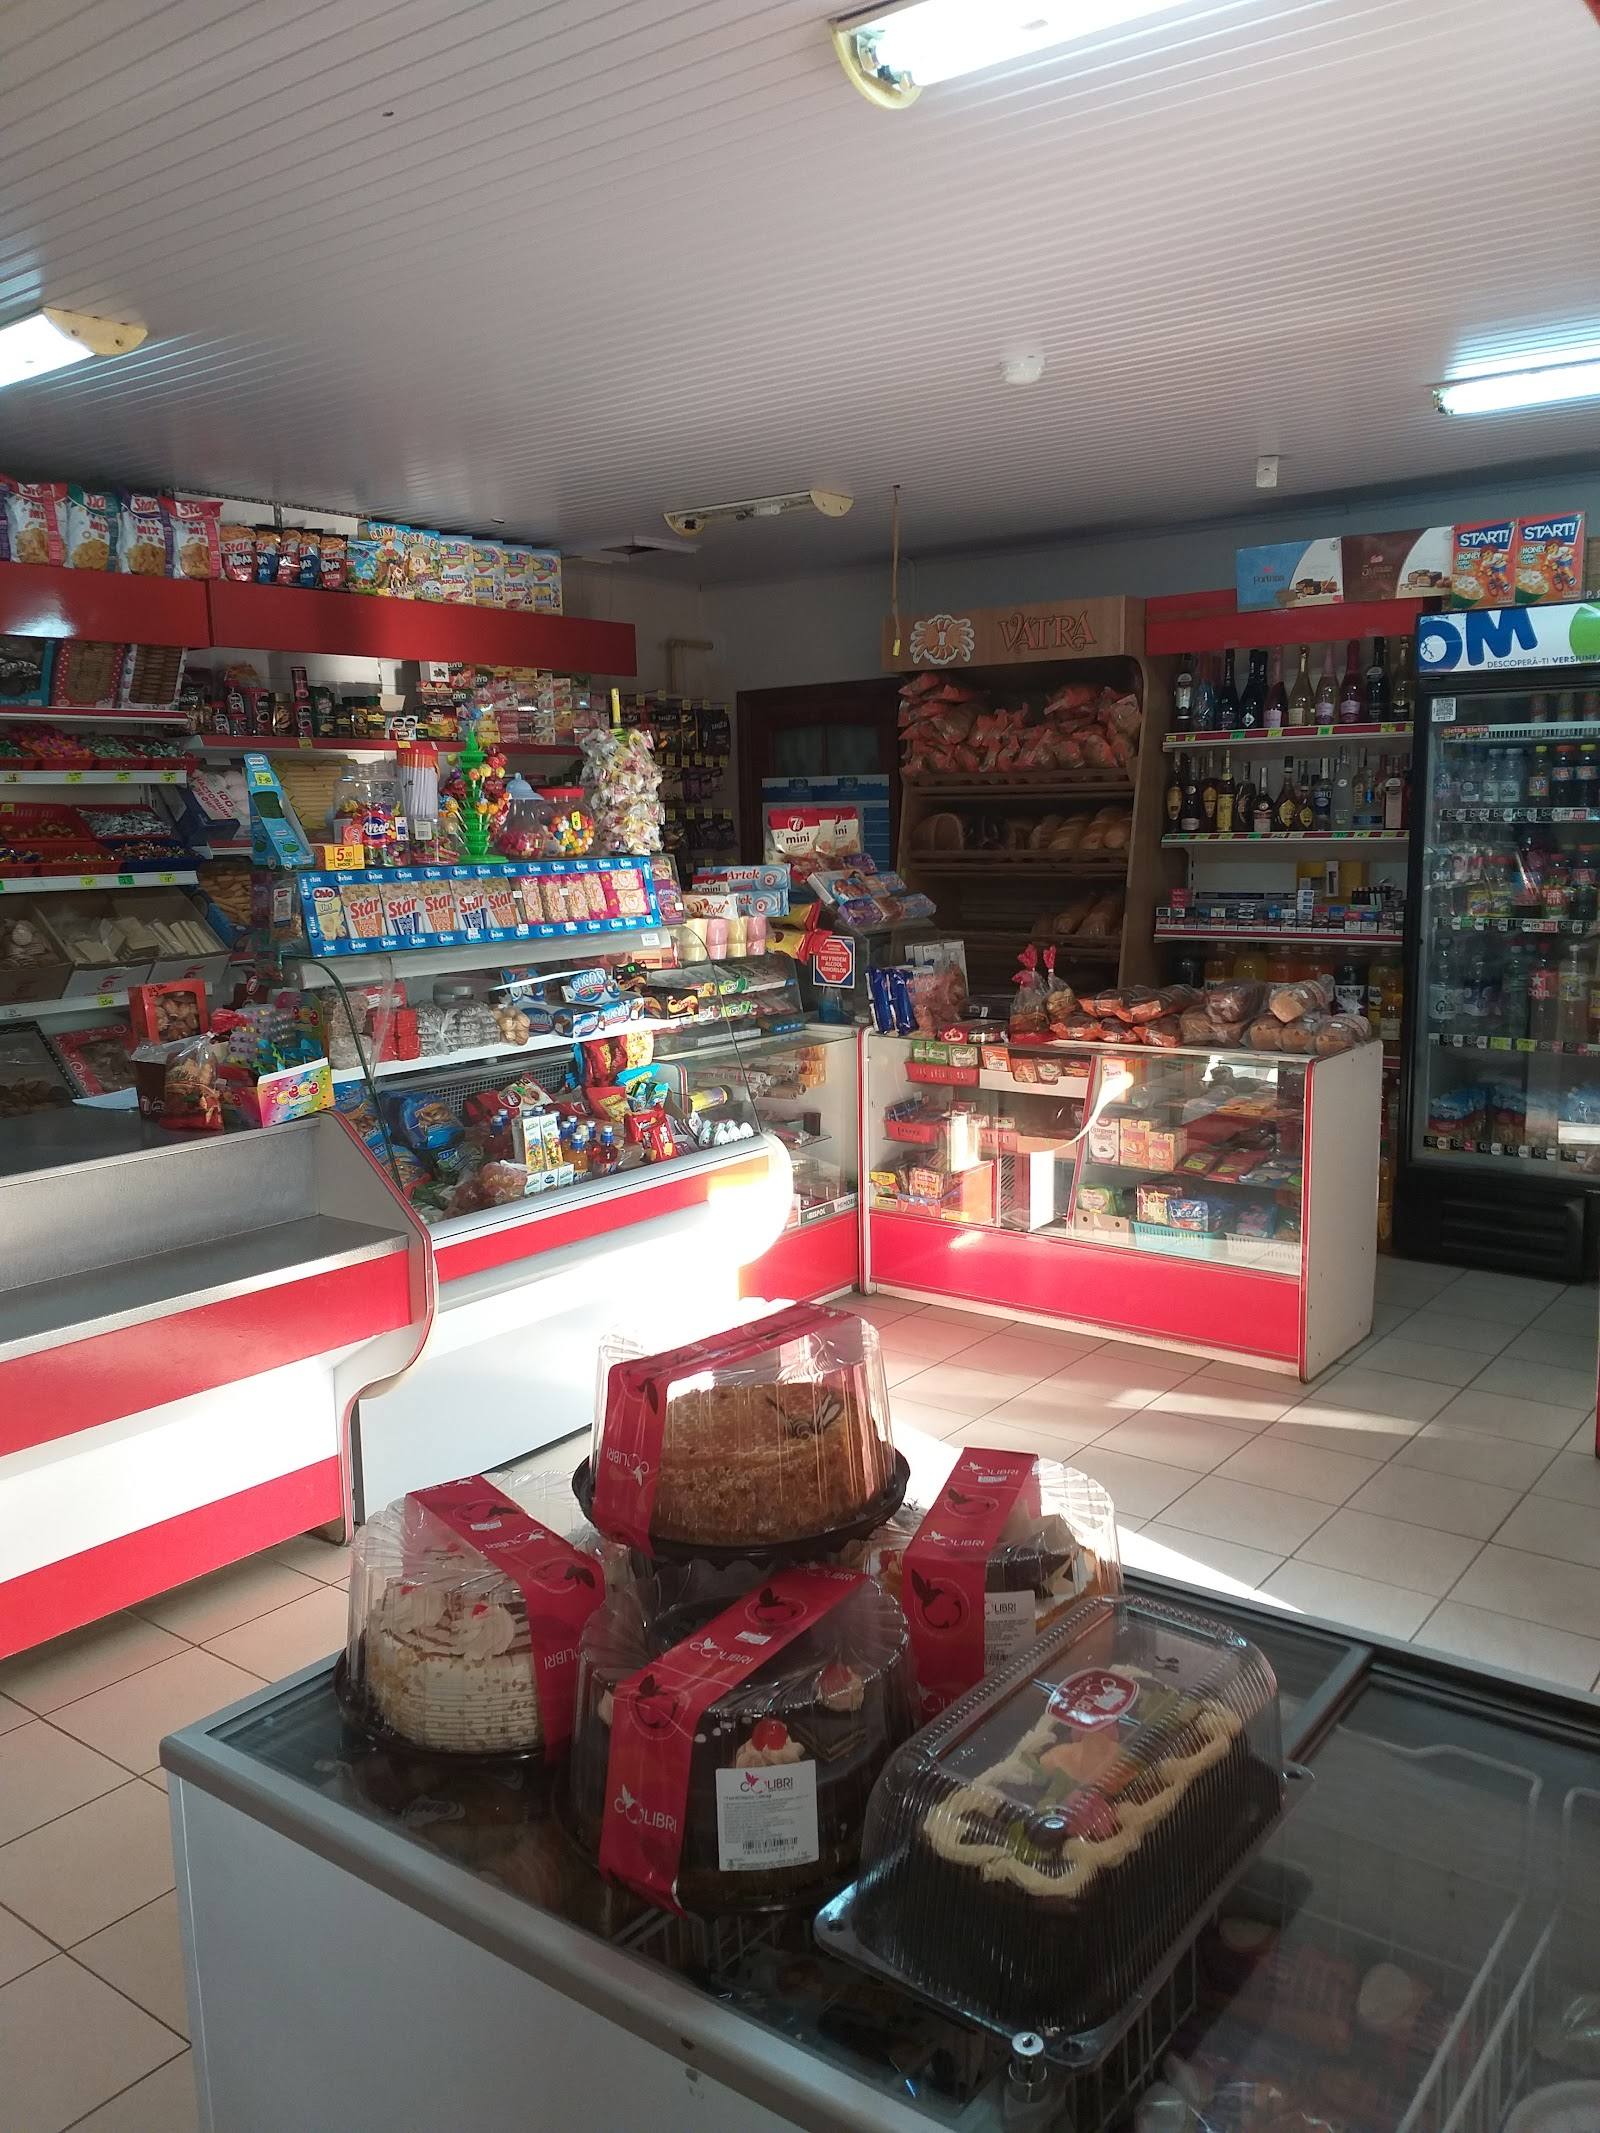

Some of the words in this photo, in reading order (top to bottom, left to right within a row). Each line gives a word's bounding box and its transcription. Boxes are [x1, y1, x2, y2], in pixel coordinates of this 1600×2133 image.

[1459, 529, 1509, 547] START!
[1524, 521, 1576, 541] START!
[1000, 607, 1097, 653] VATRA
[785, 832, 810, 844] mini
[727, 867, 760, 882] Artek
[350, 896, 380, 920] Star
[386, 896, 418, 919] Star
[424, 894, 452, 913] Star
[488, 891, 513, 910] Star
[739, 1773, 793, 1794] COLIBRI
